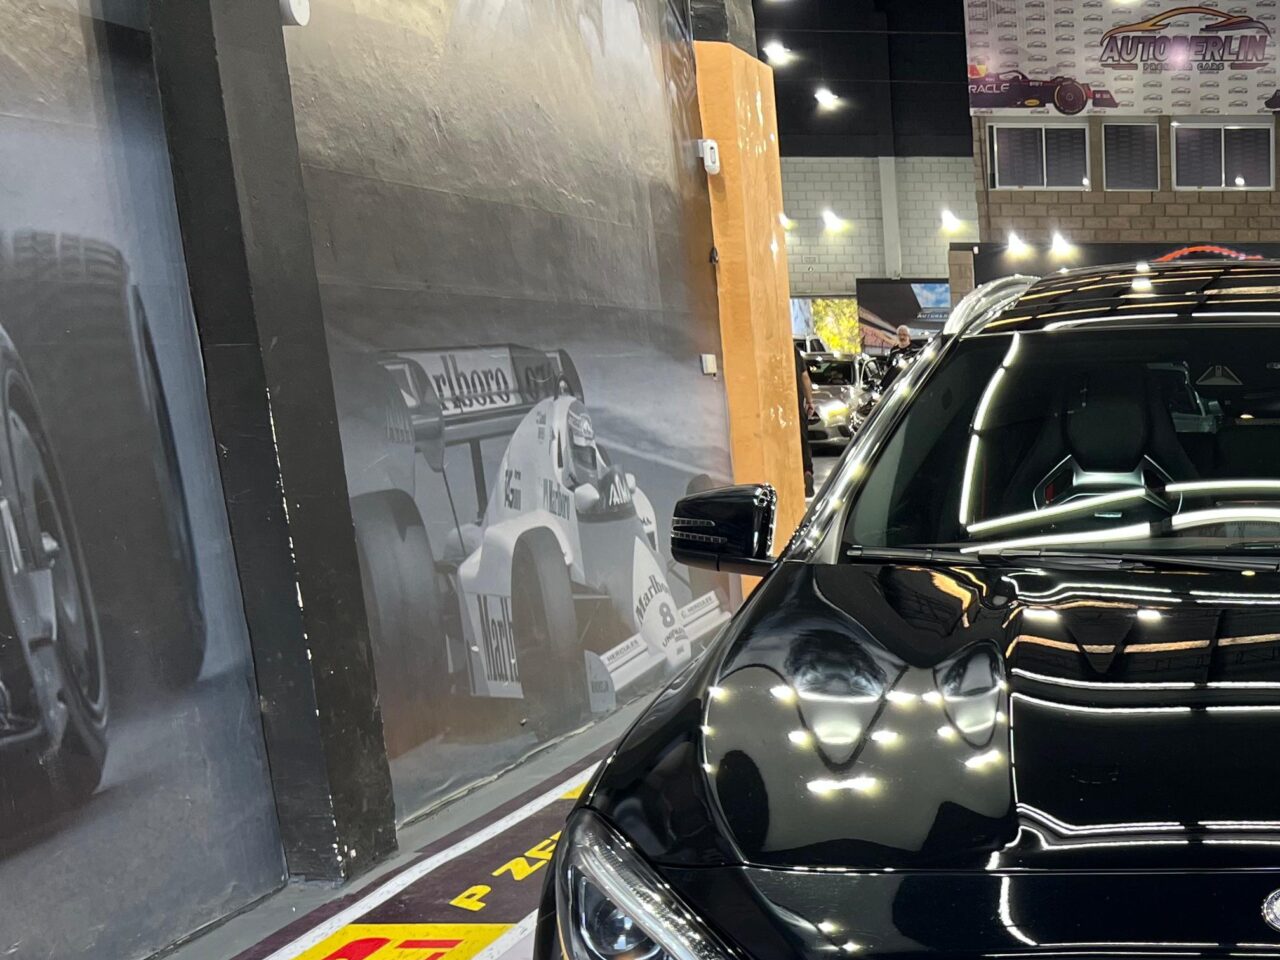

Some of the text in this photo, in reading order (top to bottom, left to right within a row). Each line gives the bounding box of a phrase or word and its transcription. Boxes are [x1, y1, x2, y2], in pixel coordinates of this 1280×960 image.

[432, 354, 511, 412] rlboro
[659, 601, 676, 628] 8
[448, 884, 492, 912] P
